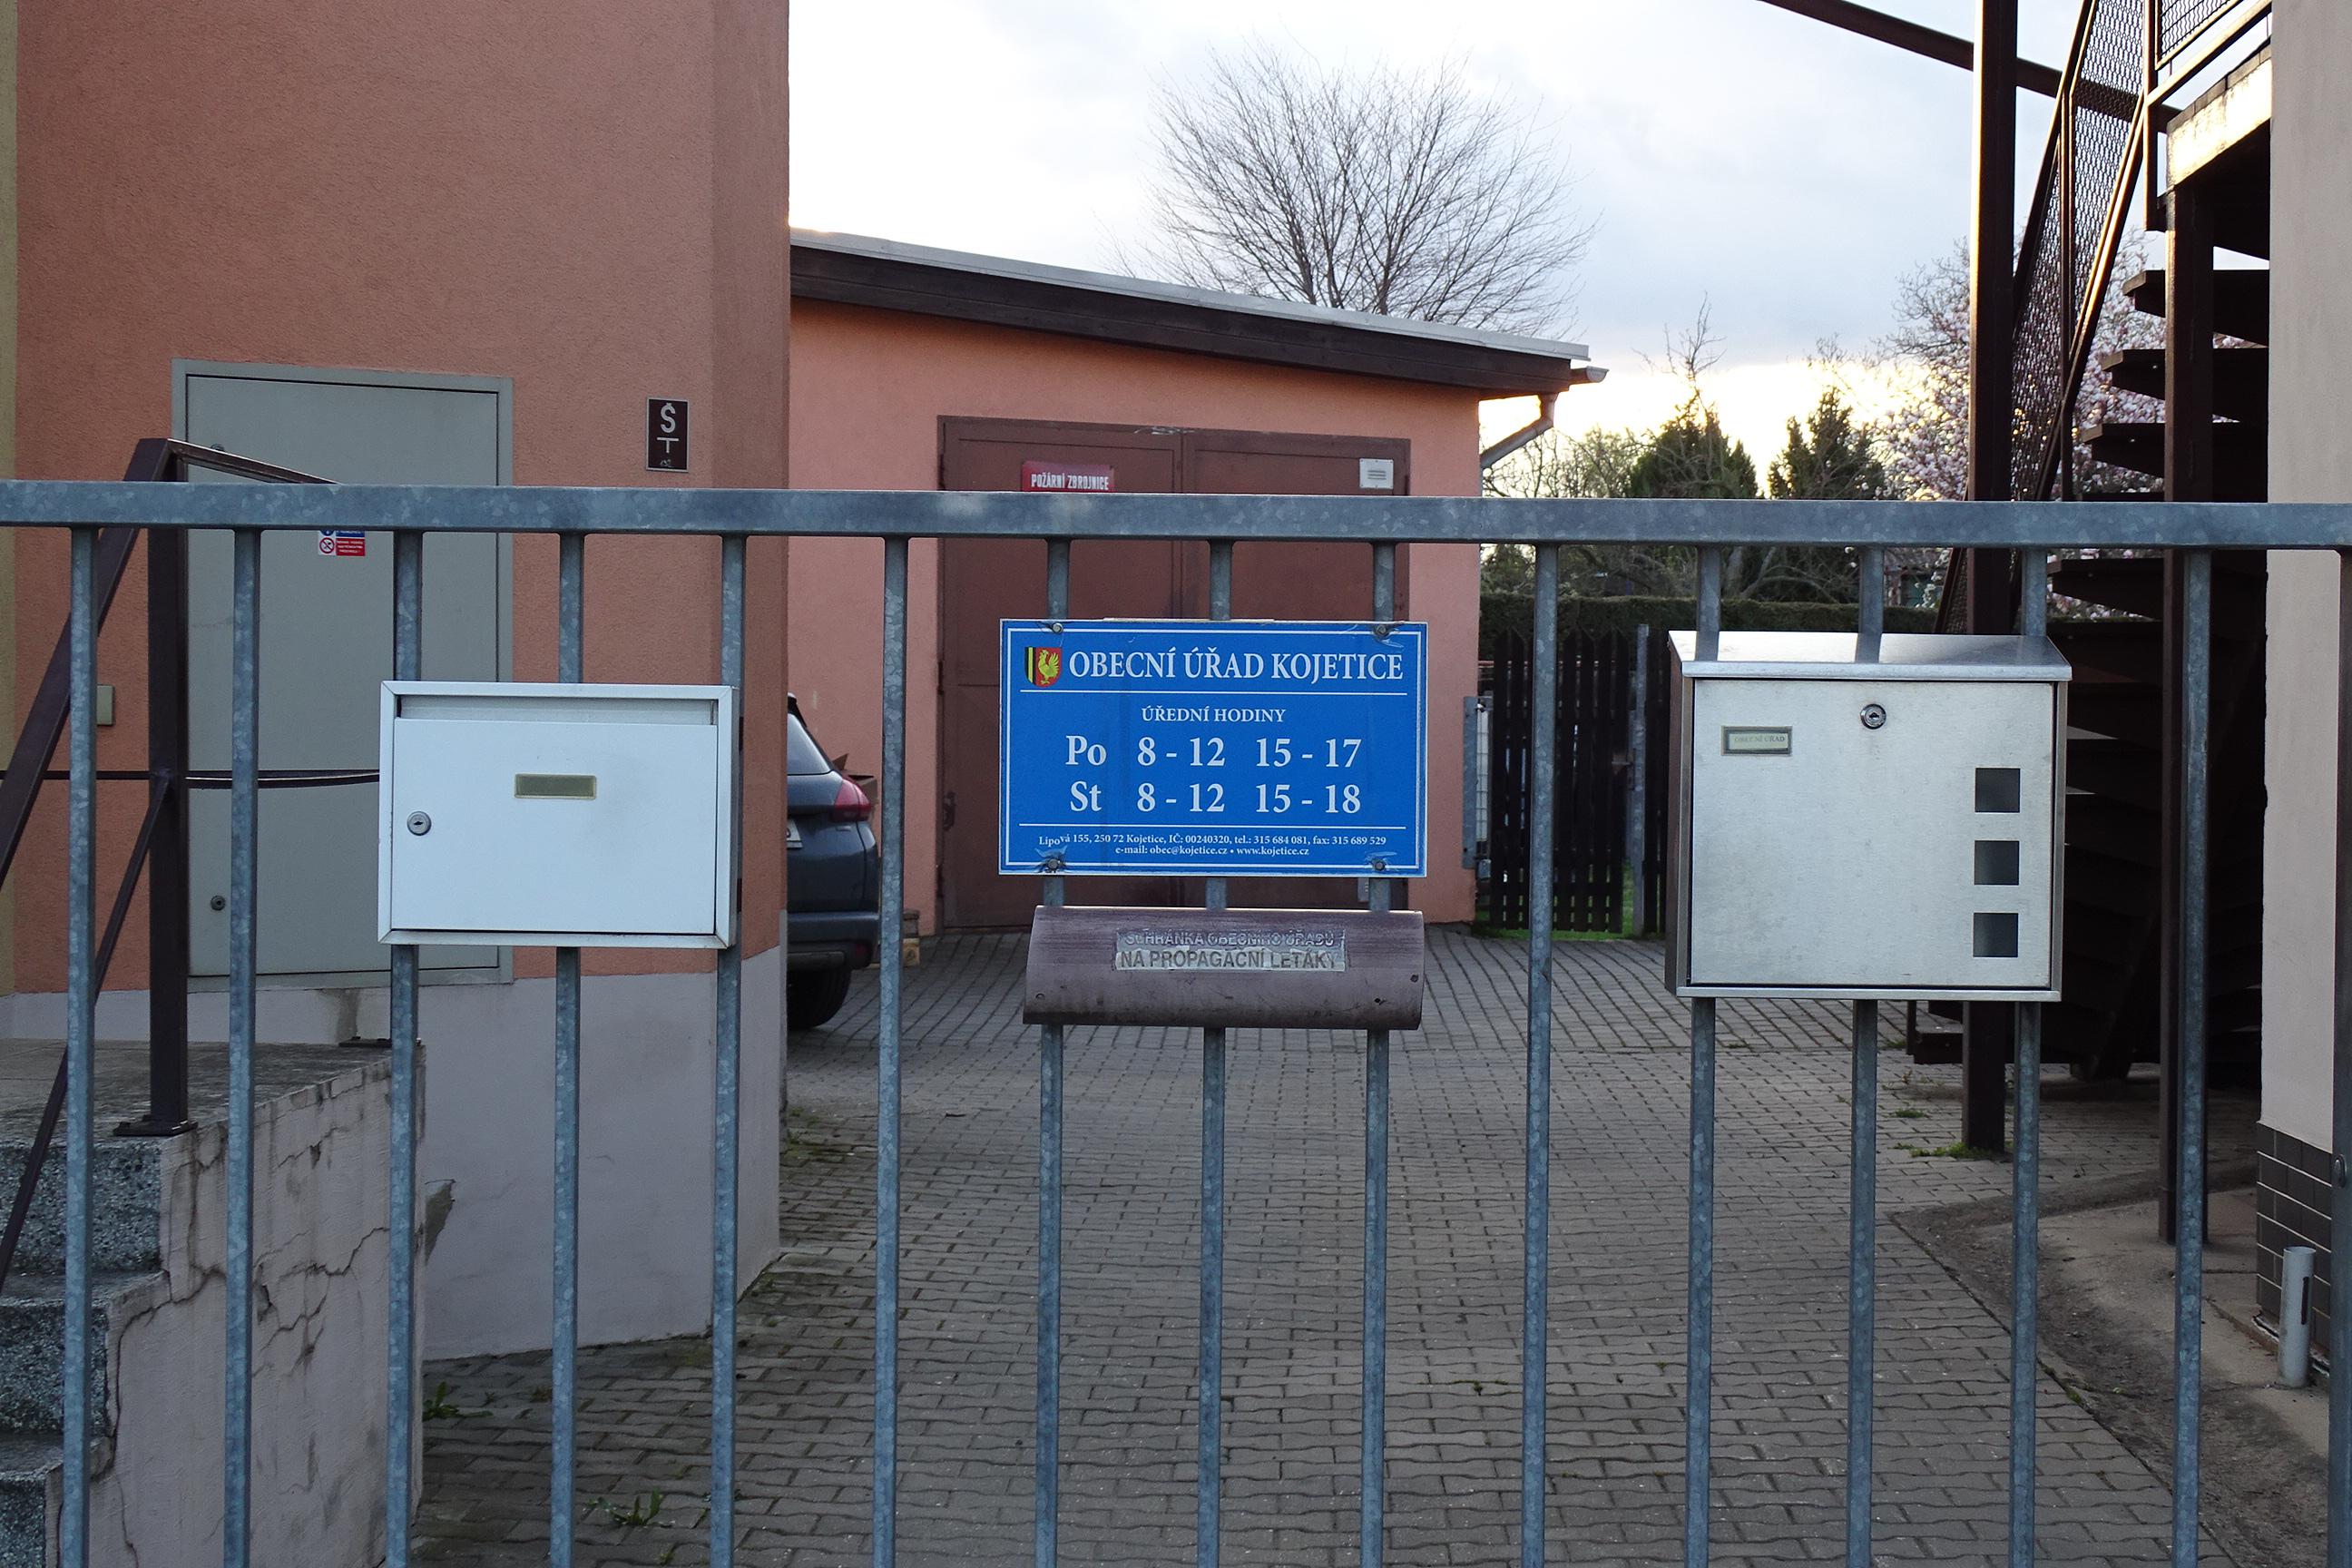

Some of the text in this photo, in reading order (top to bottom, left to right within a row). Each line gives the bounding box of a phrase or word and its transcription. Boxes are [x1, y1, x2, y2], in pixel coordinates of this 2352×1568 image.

[1031, 472, 1109, 490] POŽÁRNÍ ZBROJNICE
[1069, 646, 1404, 684] OBECNÍ ÚŘAD KOJETICE
[1142, 705, 1286, 723] ÚŘEDNÍ HODINY
[1065, 735, 1107, 766] Po
[1137, 737, 1156, 766] 8
[1190, 737, 1225, 766] 12
[1256, 738, 1291, 768] 15
[1325, 738, 1362, 768] 17
[1070, 780, 1102, 812] St
[1137, 782, 1156, 812] 8
[1189, 783, 1225, 812] 12
[1256, 784, 1291, 813] 15
[1325, 784, 1361, 814] 18
[1039, 833, 1387, 847] Lipová 155, 250 72 Kojetice, IČ: 00240320, tel.: 315 684 081, fax: 315 689 529
[1115, 845, 1309, 857] e-mail: obec@kojetice.cz www.kojetice.cz
[1122, 950, 1144, 967] NA
